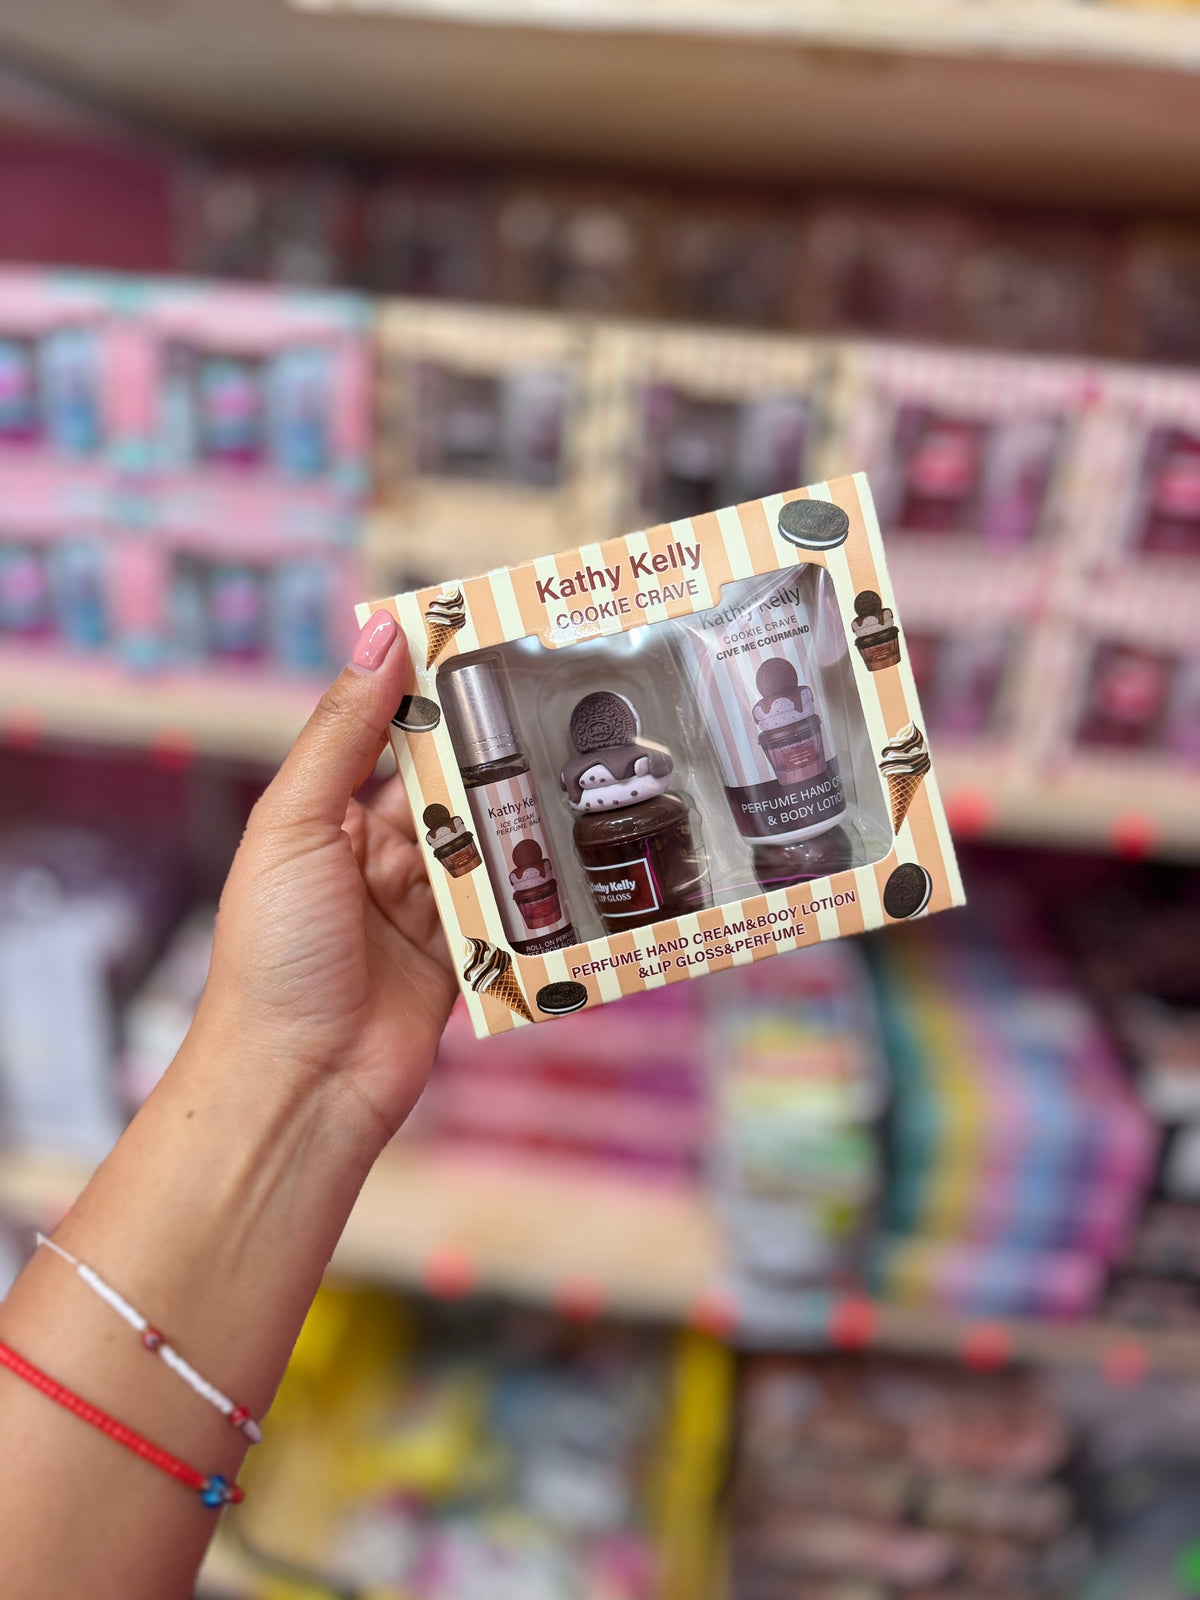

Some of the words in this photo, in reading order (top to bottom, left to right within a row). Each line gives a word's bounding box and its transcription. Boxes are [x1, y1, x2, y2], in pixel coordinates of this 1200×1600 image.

[536, 565, 621, 603] Kathy
[629, 542, 701, 578] Kelly
[556, 597, 631, 630] COOKIE
[635, 579, 699, 609] CRAVE
[724, 626, 763, 645] COOKIE
[765, 615, 797, 632] CRAVE
[741, 642, 757, 653] ME
[741, 793, 798, 813] PERFUME
[800, 781, 831, 800] HAND
[488, 802, 521, 819] Kathy
[500, 820, 511, 828] ICE
[513, 813, 534, 825] CREAM
[768, 815, 778, 826] &
[780, 803, 814, 823] BODY
[496, 823, 527, 835] PERFUME
[609, 879, 636, 891] Kelly
[607, 892, 632, 902] GLOSS
[571, 949, 643, 979] PERFUME
[646, 937, 689, 958] HAND
[802, 891, 855, 915] LOTION
[526, 944, 544, 952] ROLL
[638, 960, 671, 978] &LIP
[675, 923, 806, 968] GLOSS&PERFUME
